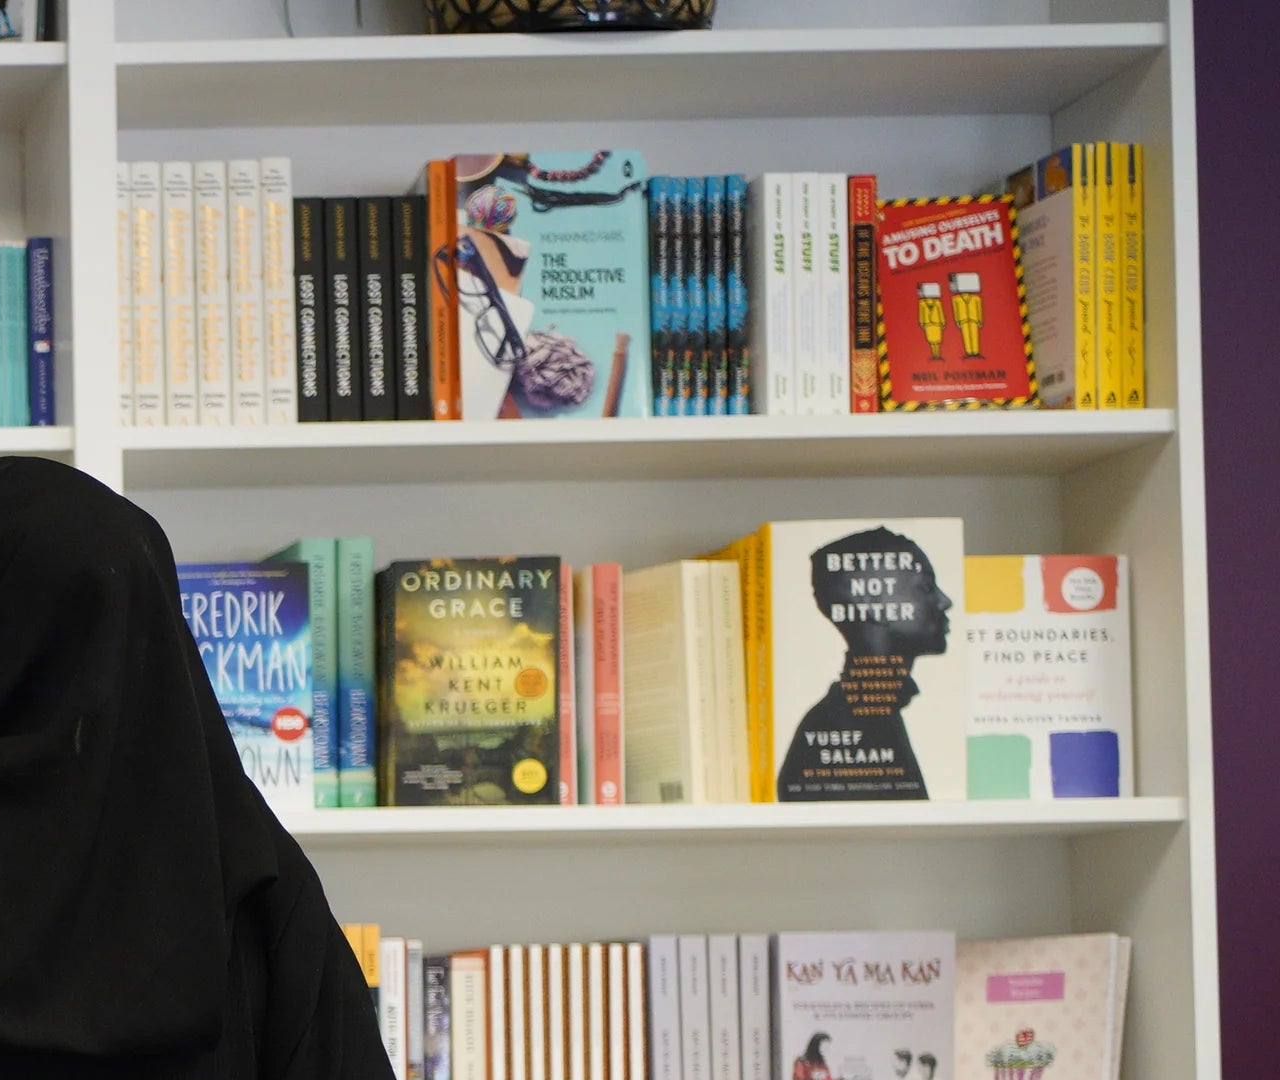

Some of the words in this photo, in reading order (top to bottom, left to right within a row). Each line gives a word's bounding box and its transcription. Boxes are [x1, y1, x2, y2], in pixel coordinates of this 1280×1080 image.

[882, 222, 938, 244] AMUSING
[774, 233, 785, 275] STUFF
[802, 232, 813, 273] STUFF
[885, 244, 921, 269] TO
[923, 224, 1004, 260] DEATH
[542, 254, 567, 268] THE
[542, 269, 625, 285] PRODUCTIVE
[300, 275, 314, 306] LOST
[334, 274, 348, 306] LOST
[542, 286, 595, 300] MUSLIM
[301, 308, 318, 397] CONNECTIONS
[335, 308, 351, 397] CONNECTIONS
[826, 552, 923, 574] BETTER,
[400, 569, 552, 591] ORDINARY
[851, 578, 897, 596] NOT
[429, 597, 524, 618] GRACE
[831, 602, 914, 622] BITTER
[966, 629, 988, 642] ET
[428, 655, 523, 669] WILLIAM
[984, 650, 1025, 663] FIND
[1033, 650, 1089, 663] PEACE
[448, 679, 504, 693] KENT
[424, 699, 526, 714] KRUEGER
[805, 730, 862, 746] YUSEF
[820, 749, 894, 764] SALAAM
